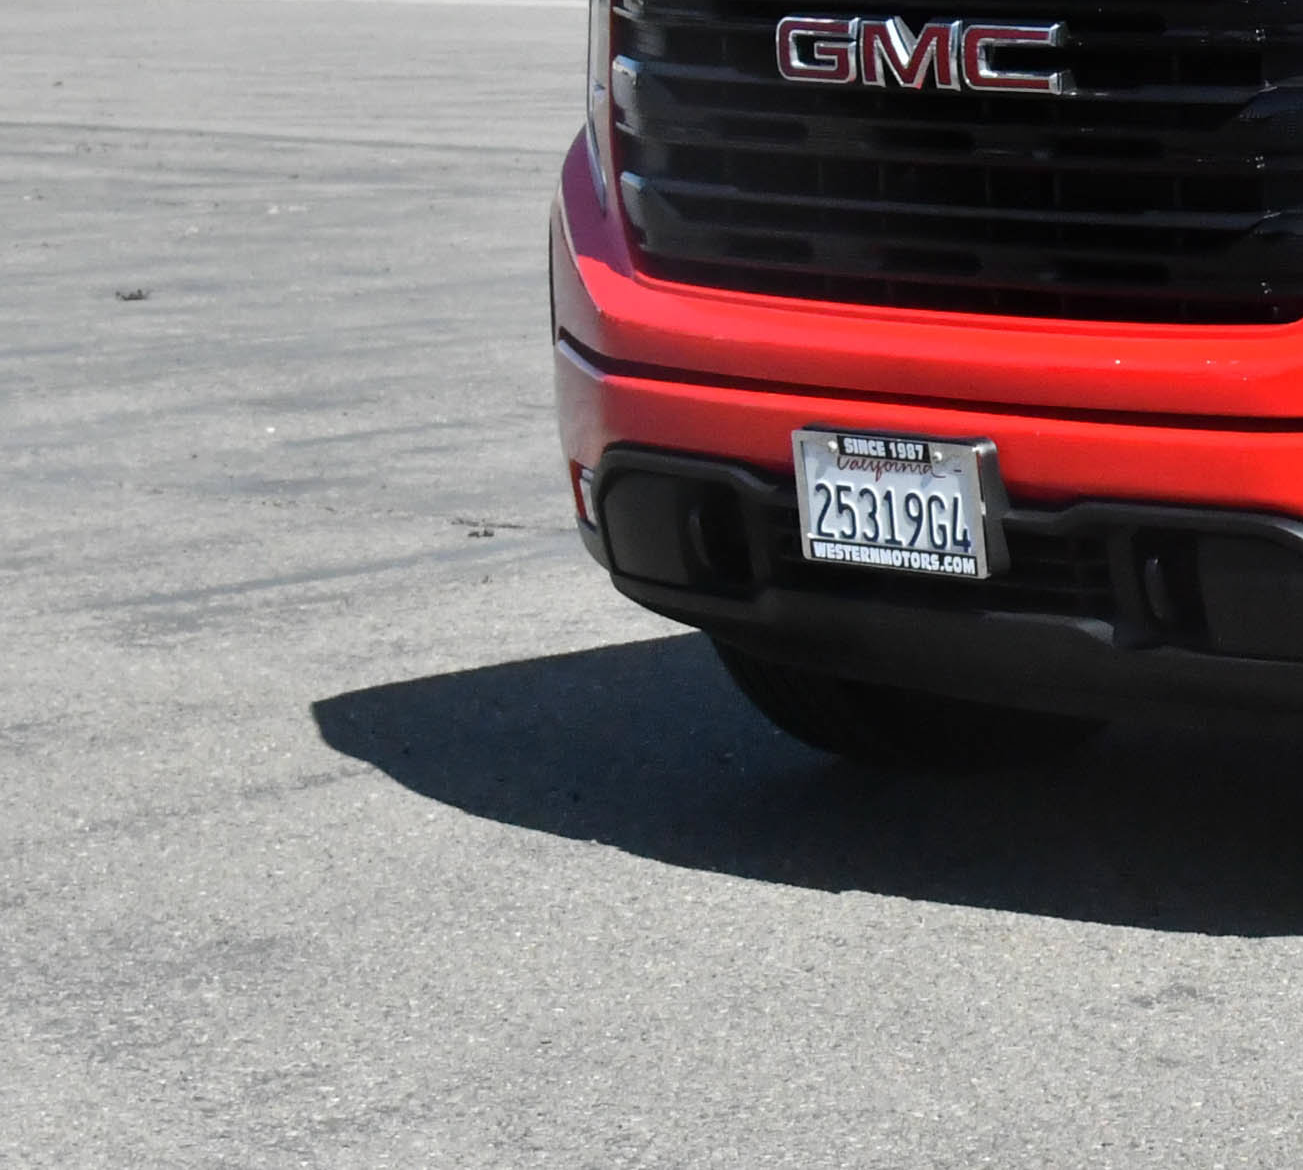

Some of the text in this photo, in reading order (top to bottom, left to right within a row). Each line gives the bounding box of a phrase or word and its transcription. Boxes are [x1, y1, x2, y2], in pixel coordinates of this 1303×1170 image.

[776, 15, 1065, 95] GMC
[843, 437, 924, 461] SINCE 1987
[814, 482, 972, 555] 25319G4
[812, 540, 976, 576] WESTERNMOTORS.COM
